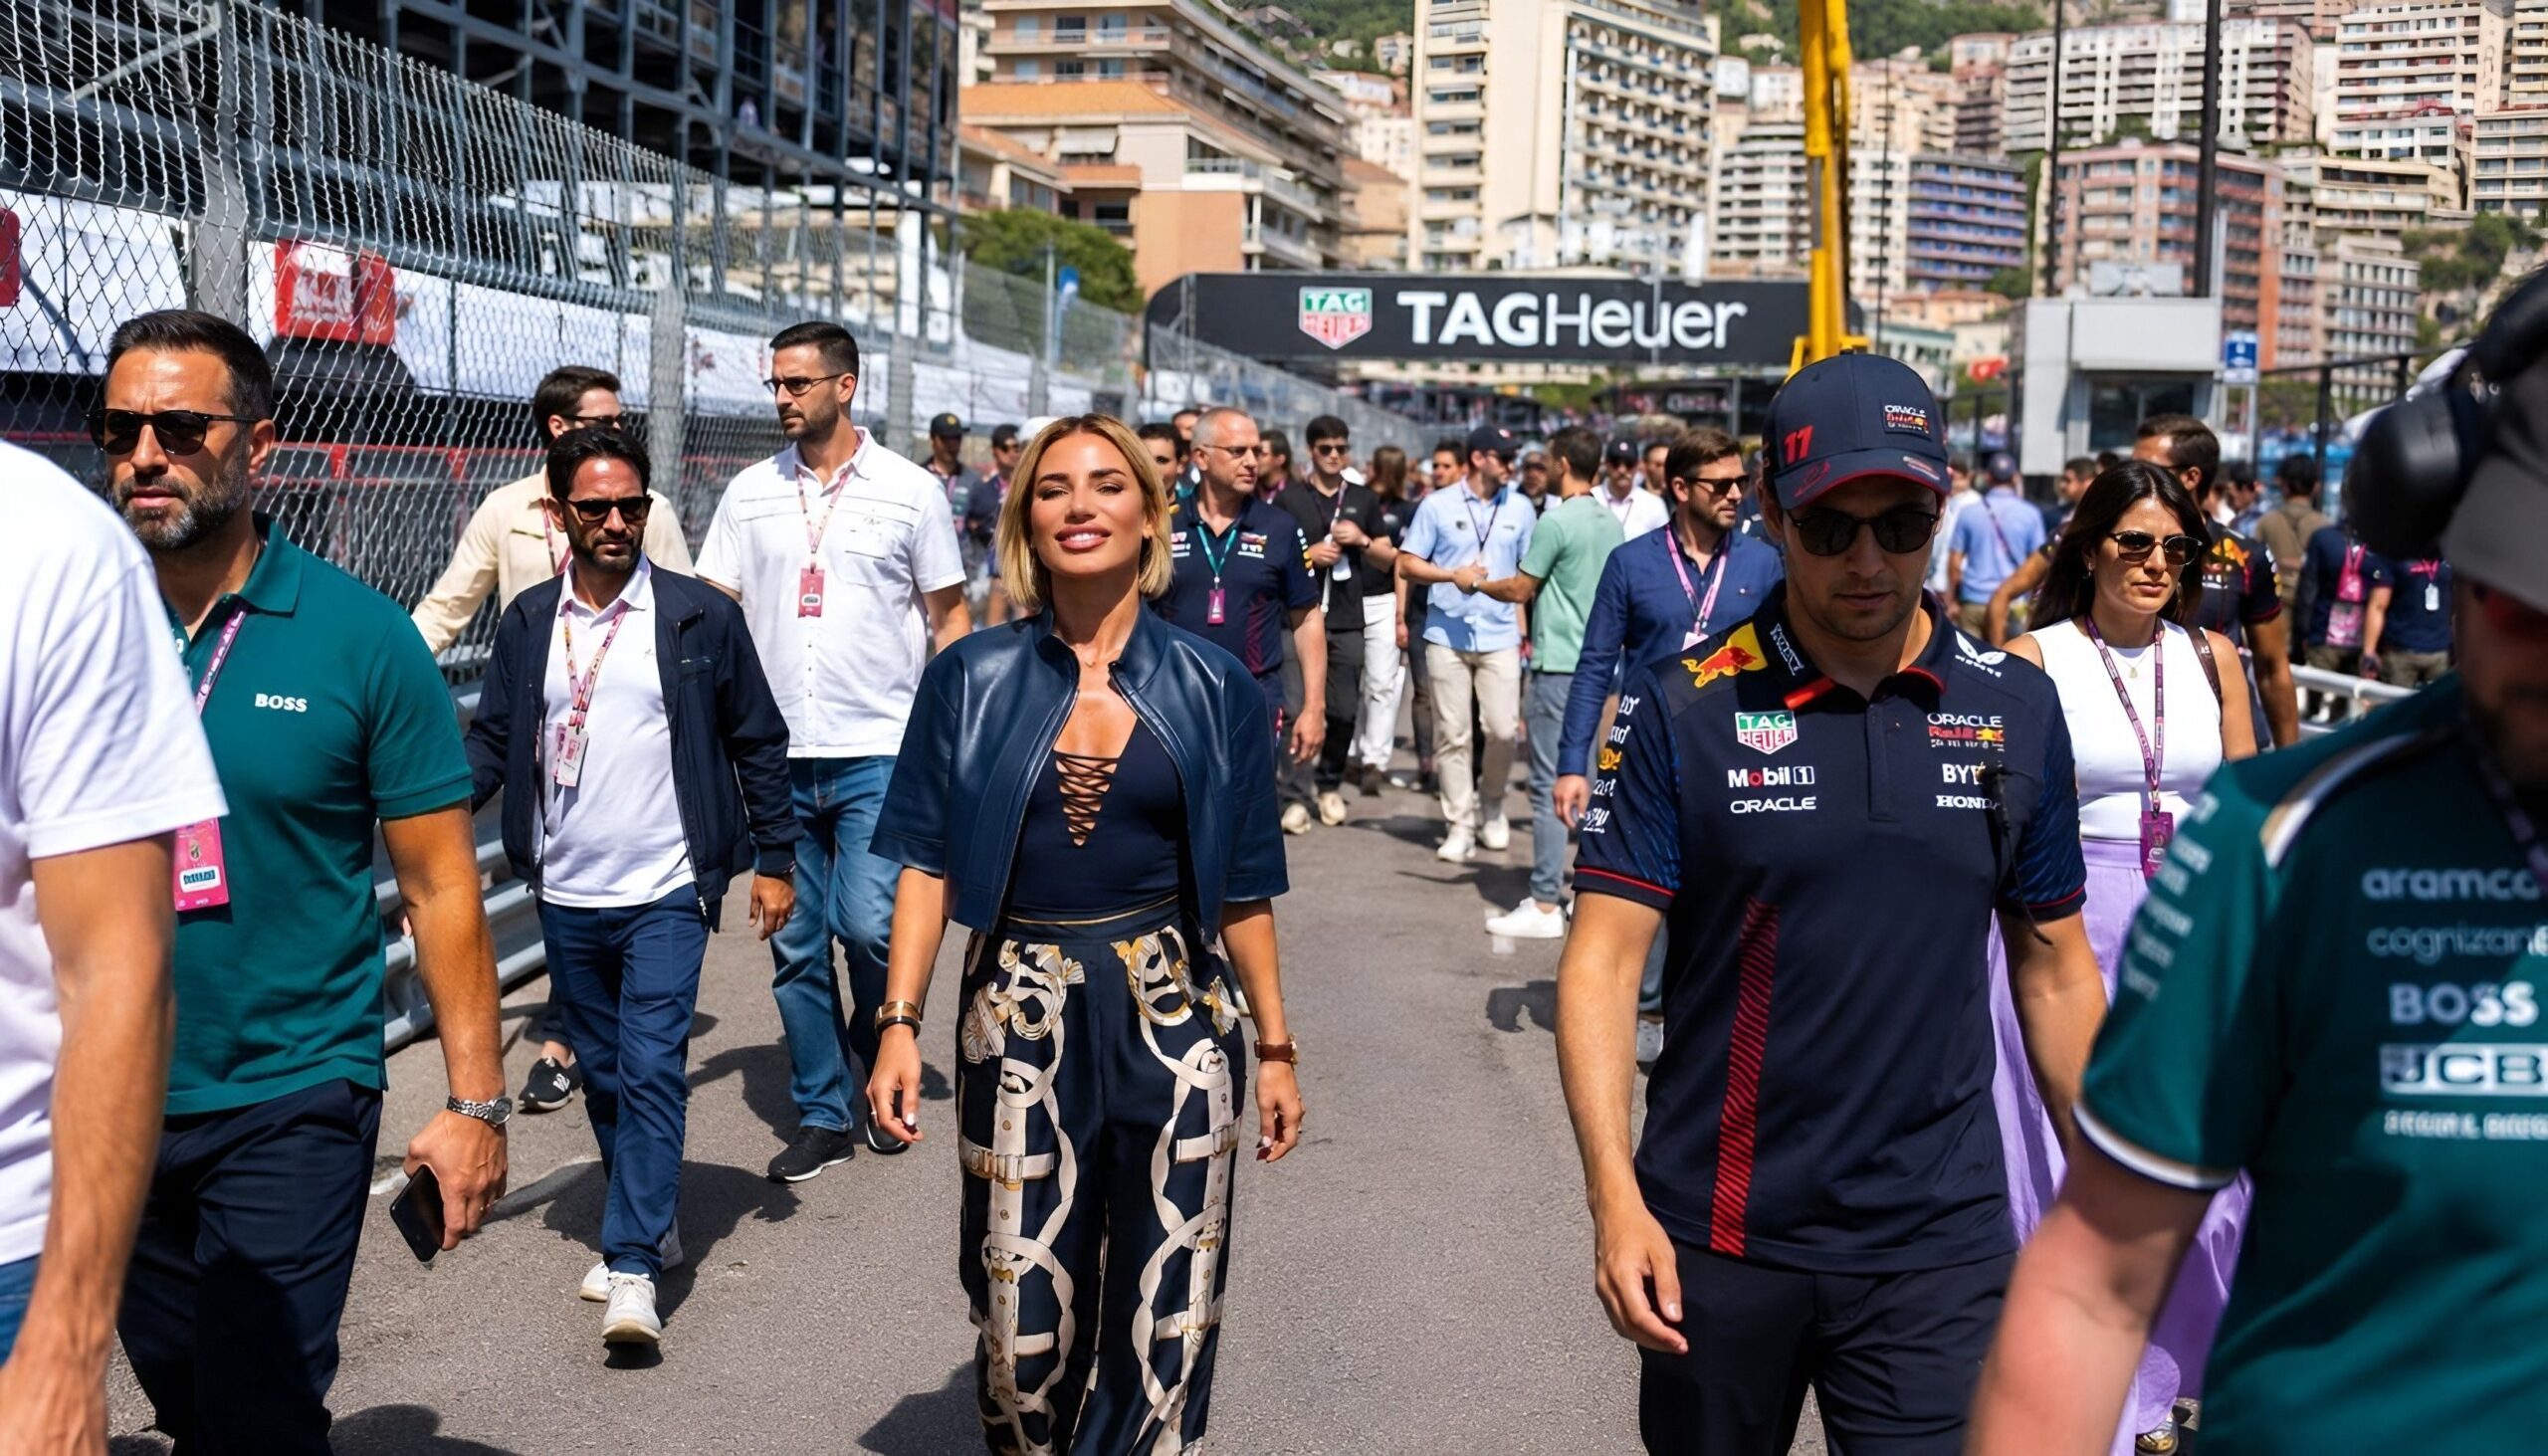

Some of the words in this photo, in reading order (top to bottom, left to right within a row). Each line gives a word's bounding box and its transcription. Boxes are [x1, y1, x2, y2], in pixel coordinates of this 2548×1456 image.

[1305, 291, 1366, 312] TAG
[1784, 424, 1814, 466] 11
[255, 694, 308, 712] BOSS
[1927, 712, 2004, 728] ORACLE
[1740, 728, 1794, 751] HEUER
[1727, 765, 1792, 788] Mobil
[1795, 766, 1813, 785] 1
[1730, 796, 1817, 814] ORACLE
[2363, 868, 2541, 900] aramco
[2389, 980, 2540, 1028] BOSS
[2382, 1049, 2546, 1088] JCB
